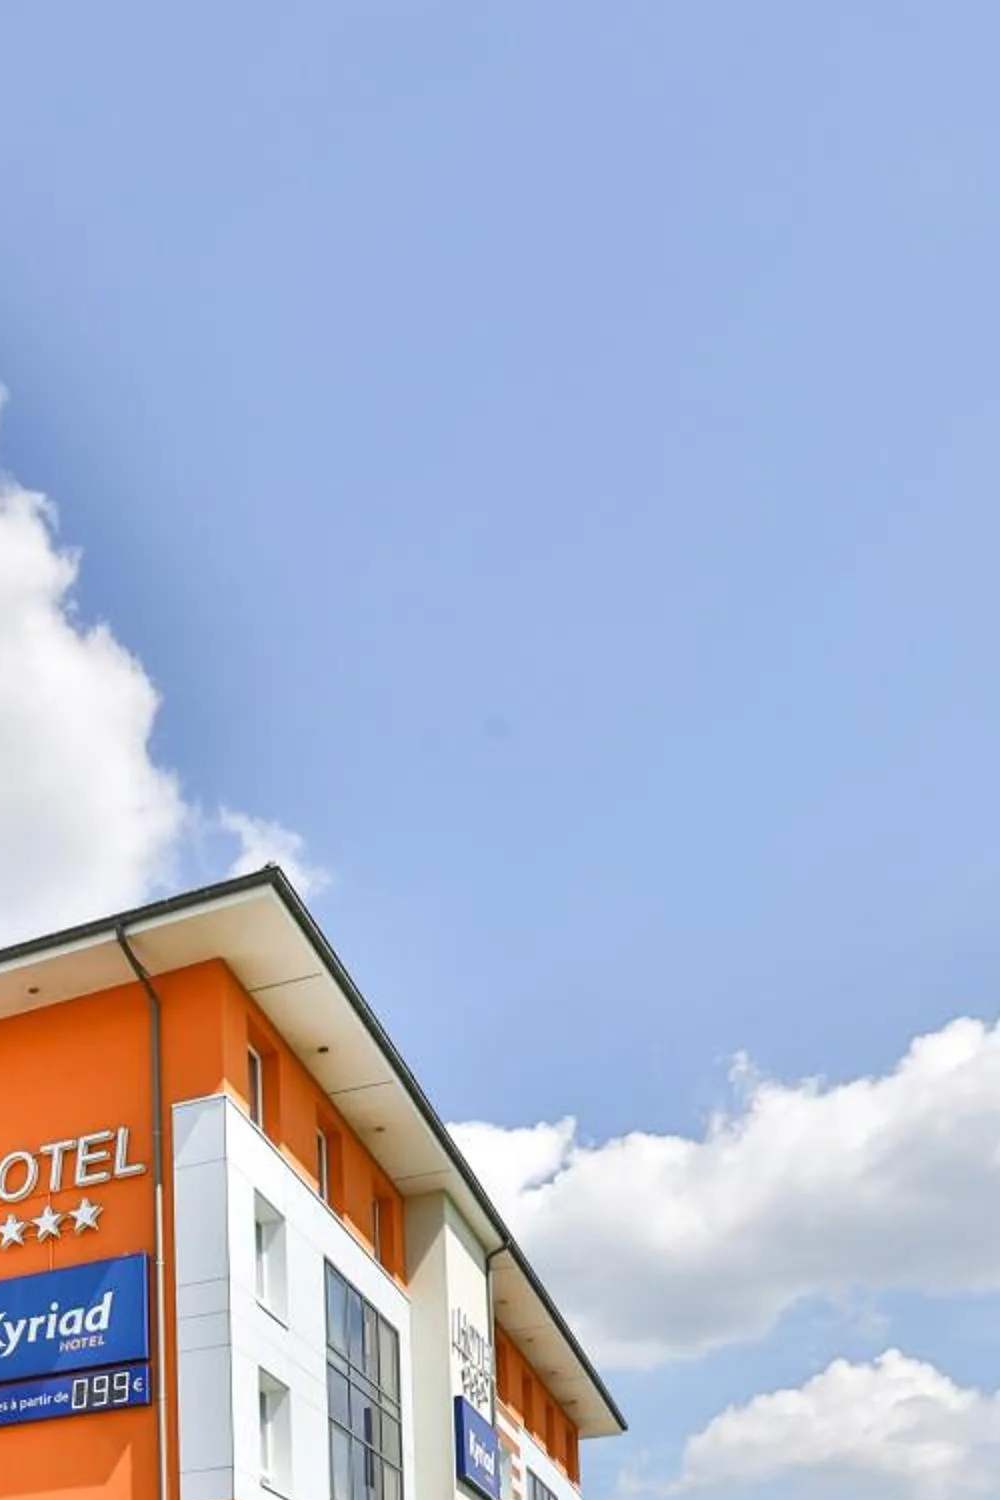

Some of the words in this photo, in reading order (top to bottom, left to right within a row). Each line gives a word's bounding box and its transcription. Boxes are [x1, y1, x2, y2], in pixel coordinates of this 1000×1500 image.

[59, 1335, 106, 1353] HOTEL
[10, 1398, 17, 1410] à
[19, 1395, 53, 1412] partir
[53, 1391, 69, 1404] de
